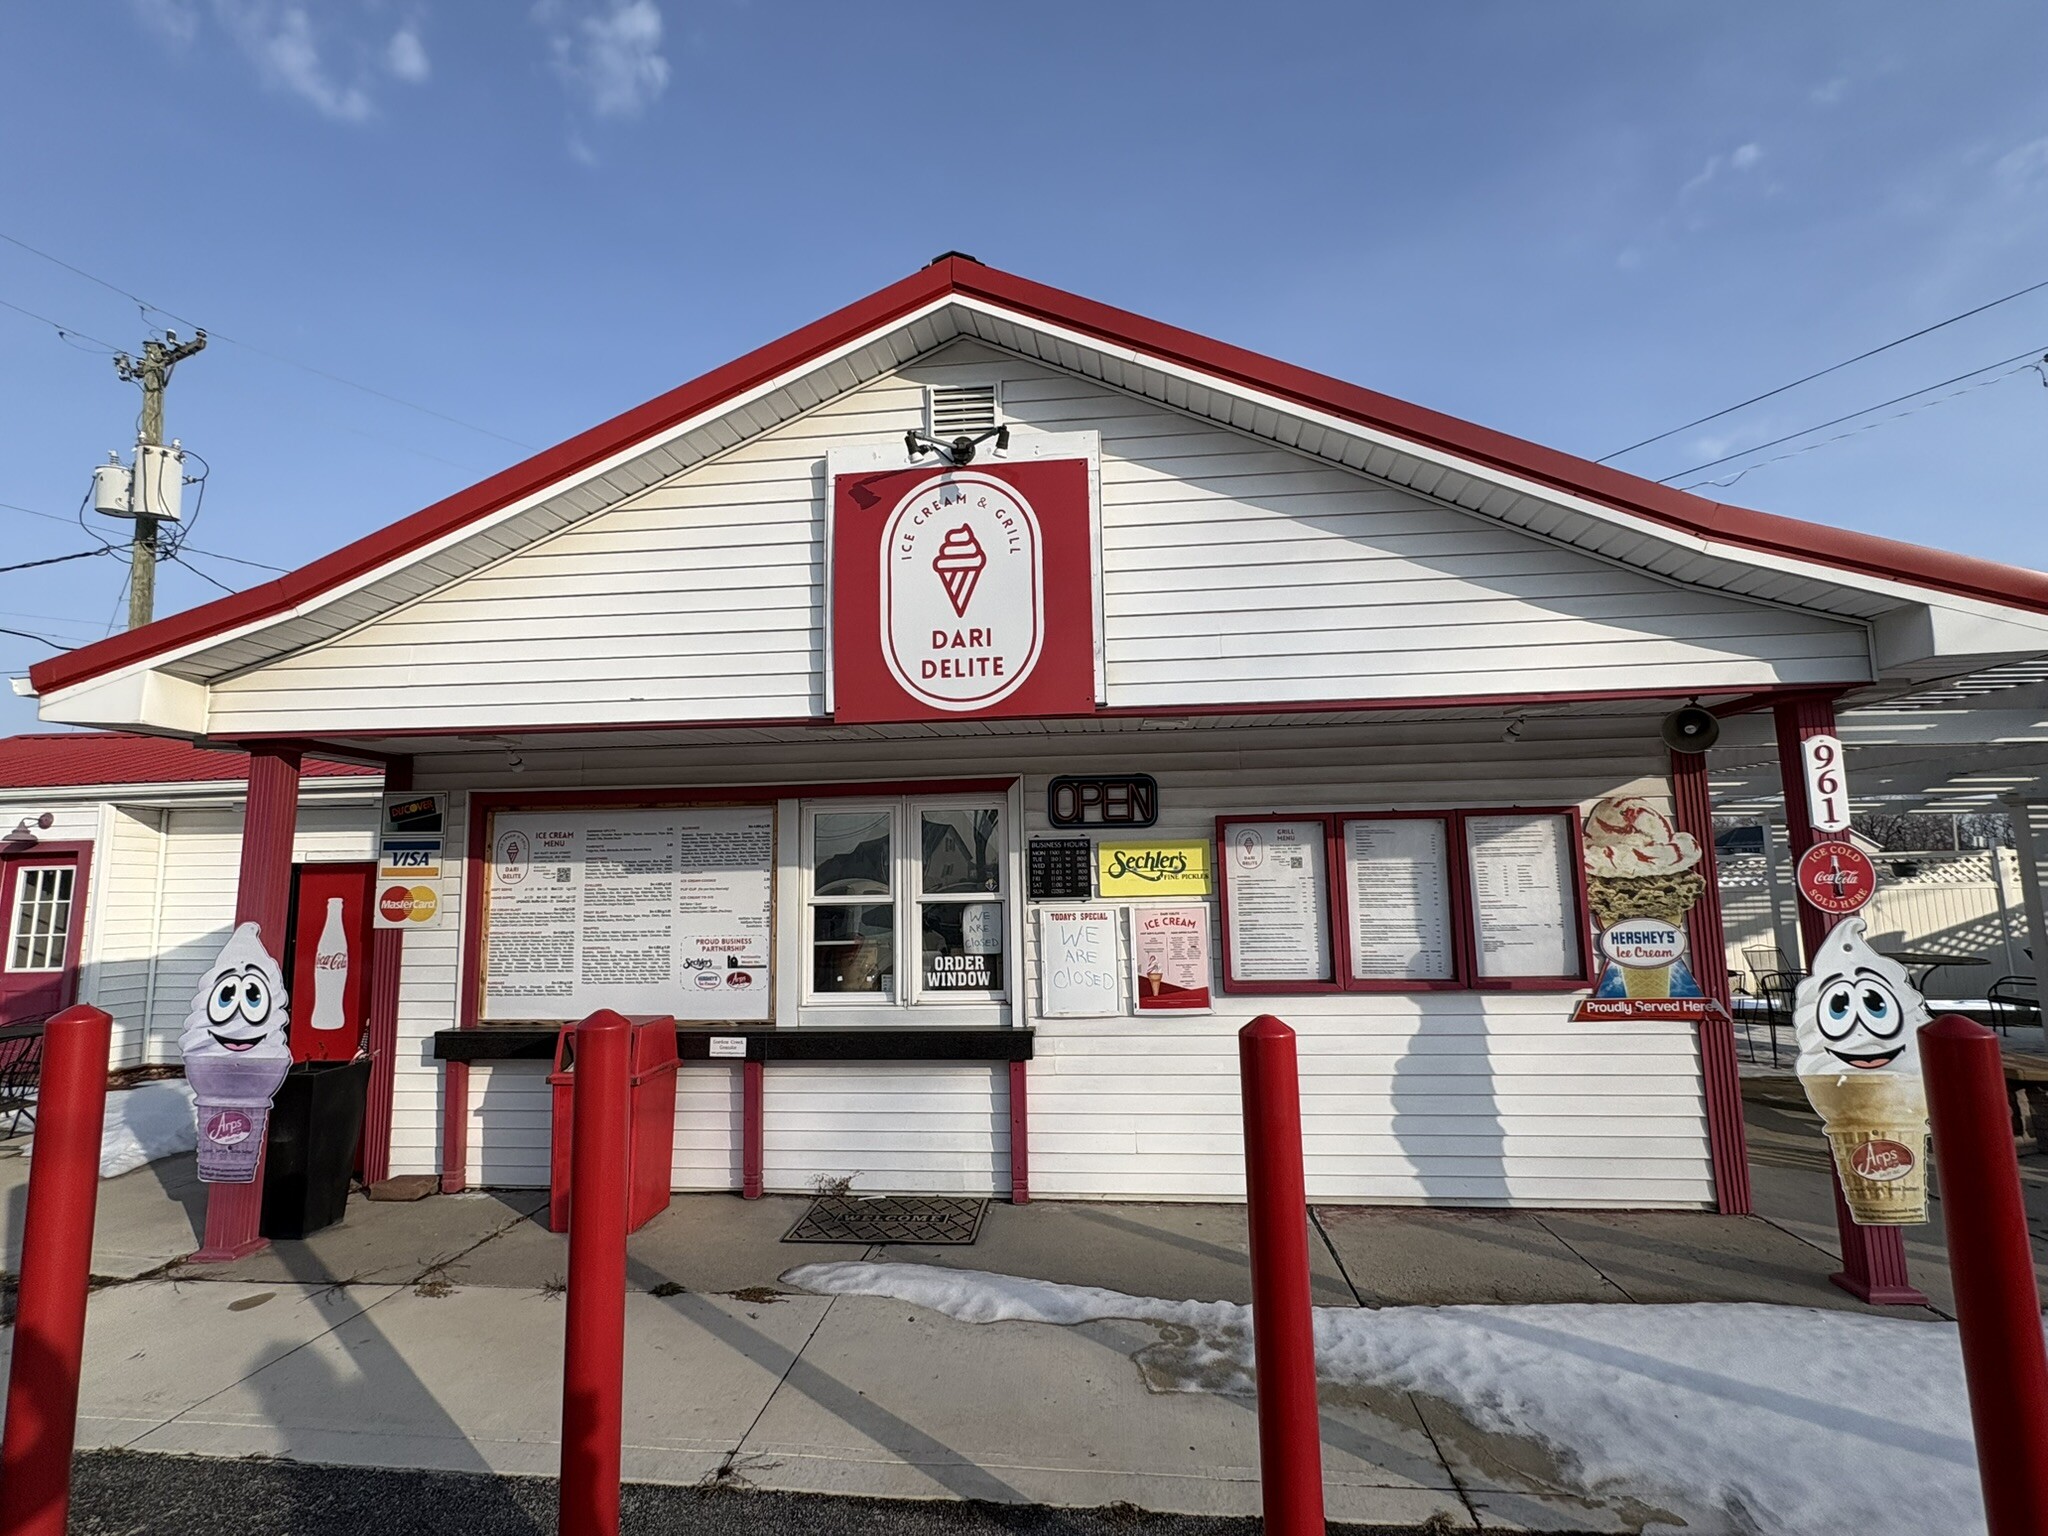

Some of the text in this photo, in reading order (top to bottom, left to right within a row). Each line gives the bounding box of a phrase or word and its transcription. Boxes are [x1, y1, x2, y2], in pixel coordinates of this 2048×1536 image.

[901, 494, 1021, 560] ICE CREAM & GRILL
[932, 627, 992, 649] DARI
[921, 656, 1004, 679] DELITE
[1813, 744, 1840, 824] 961
[1053, 782, 1152, 821] OPEN
[549, 831, 574, 839] CREAM
[392, 851, 430, 866] VISA
[1809, 845, 1861, 863] ICE COLD
[1108, 850, 1188, 881] Sechler's
[381, 899, 435, 910] MasterCard
[1809, 888, 1868, 908] SOLD HERE
[970, 911, 991, 922] WE
[1050, 913, 1108, 921] TODAY'S SPECIAL
[1144, 917, 1196, 930] ICE CREAM
[969, 924, 989, 933] ARE
[1061, 925, 1100, 947] WE
[1611, 931, 1675, 945] HERSHEY'S
[1065, 949, 1097, 964] ARE
[1616, 946, 1674, 958] Ice Cream
[934, 955, 985, 971] ORDER
[927, 971, 991, 987] WINDOW
[1586, 1002, 1632, 1015] Proudly
[1635, 1001, 1680, 1012] Served
[209, 1112, 242, 1139] Arps
[1858, 1142, 1898, 1175] Arps
[842, 1214, 943, 1222] WELCOME
